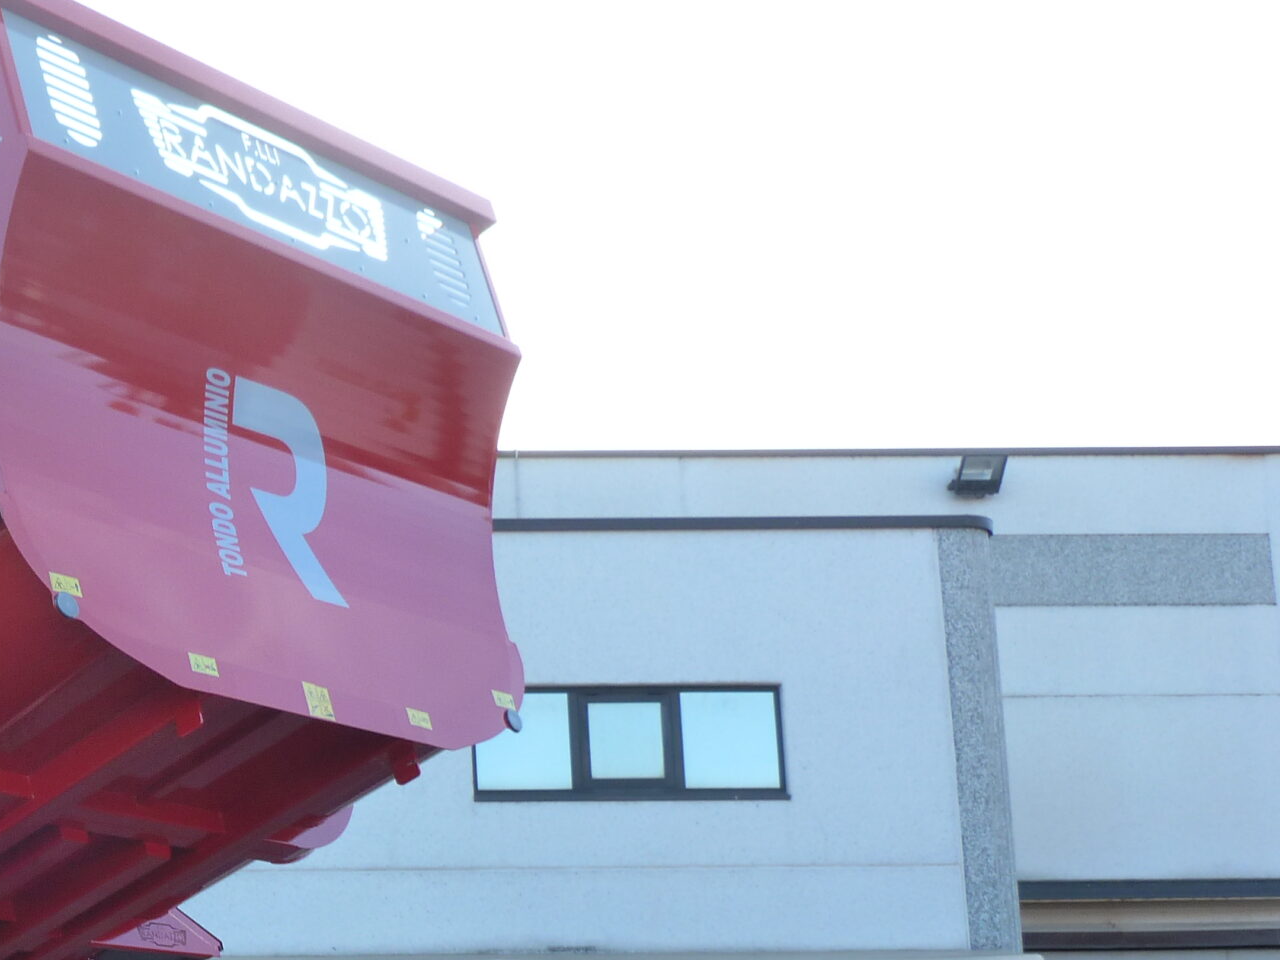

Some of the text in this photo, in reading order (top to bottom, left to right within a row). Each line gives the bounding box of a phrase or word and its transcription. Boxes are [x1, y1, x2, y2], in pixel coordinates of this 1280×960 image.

[158, 116, 371, 239] RANDAZZO
[203, 366, 248, 577] TONDO ALLUMINIO
[232, 375, 350, 608] R
